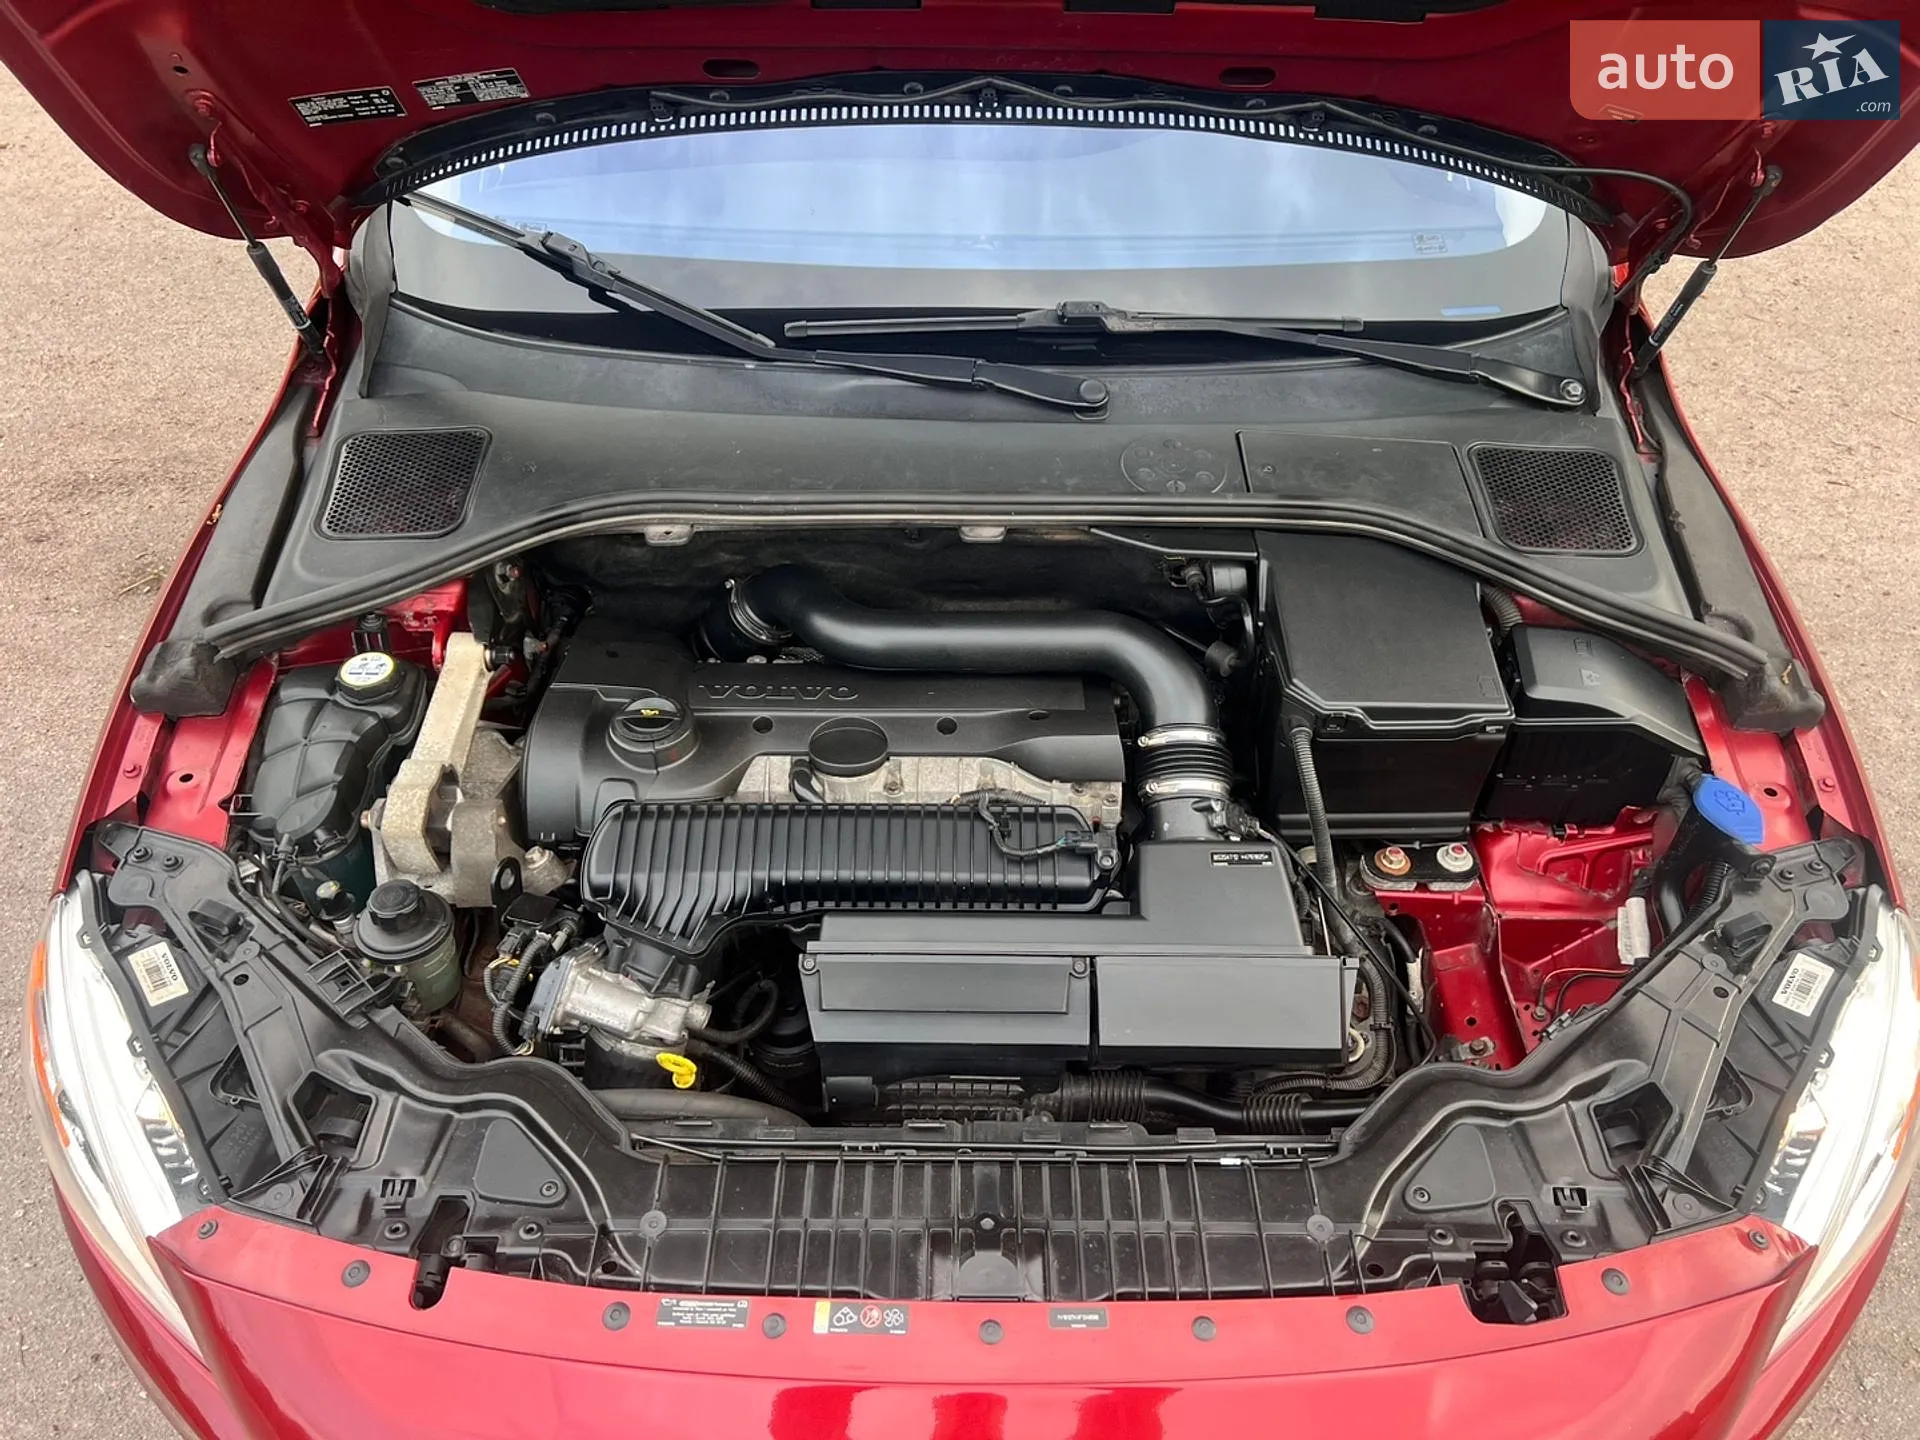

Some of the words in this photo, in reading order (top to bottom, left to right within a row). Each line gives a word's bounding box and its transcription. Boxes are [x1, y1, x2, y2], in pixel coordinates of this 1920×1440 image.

[698, 685, 858, 700] VOLVO
[161, 952, 178, 981] VOLVO
[1781, 968, 1799, 994] VOLVO
